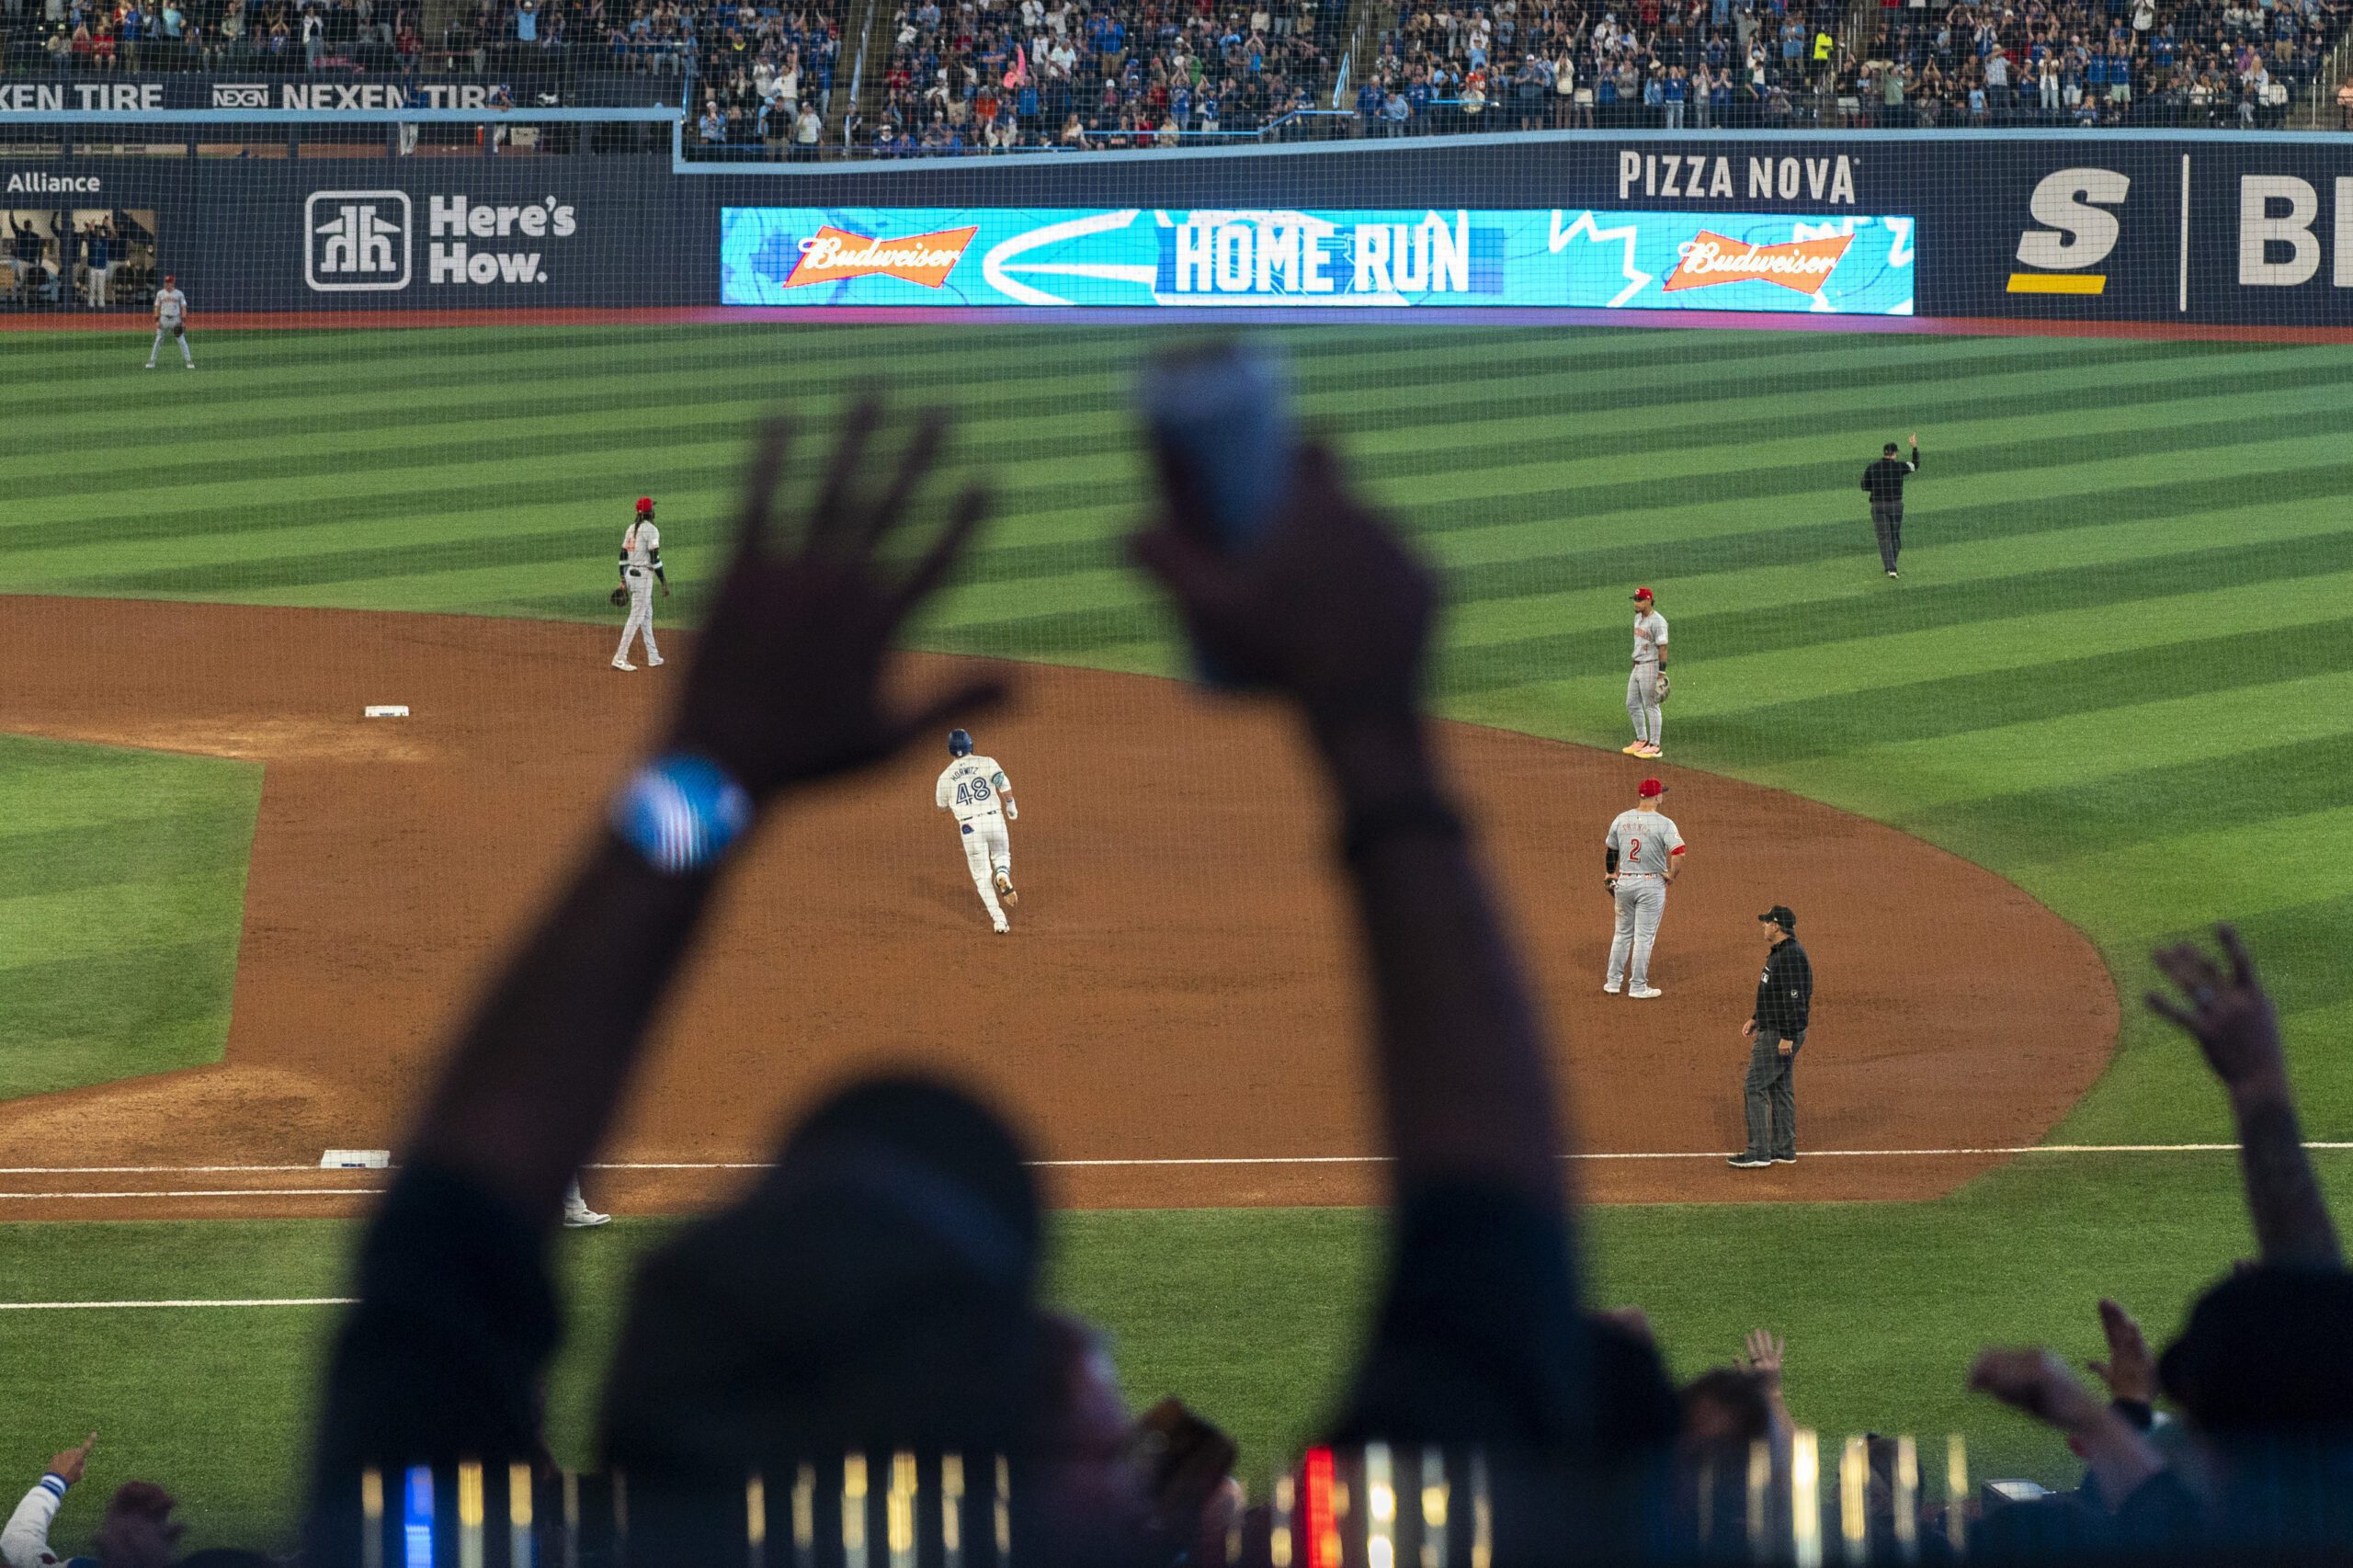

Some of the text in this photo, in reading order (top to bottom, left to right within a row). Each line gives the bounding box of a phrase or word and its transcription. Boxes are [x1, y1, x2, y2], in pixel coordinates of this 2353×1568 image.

[74, 85, 164, 110] TIRE
[7, 172, 100, 192] Alliance
[1620, 151, 1855, 204] PIZZA NOVA
[430, 196, 576, 236] Here's
[2016, 168, 2131, 269] S
[430, 243, 548, 284] How.
[798, 237, 961, 268] Budweiser
[1176, 210, 1469, 291] HOME RUN
[1677, 241, 1836, 273] Budweiser
[957, 777, 991, 805] 48
[1629, 837, 1642, 863] 2
